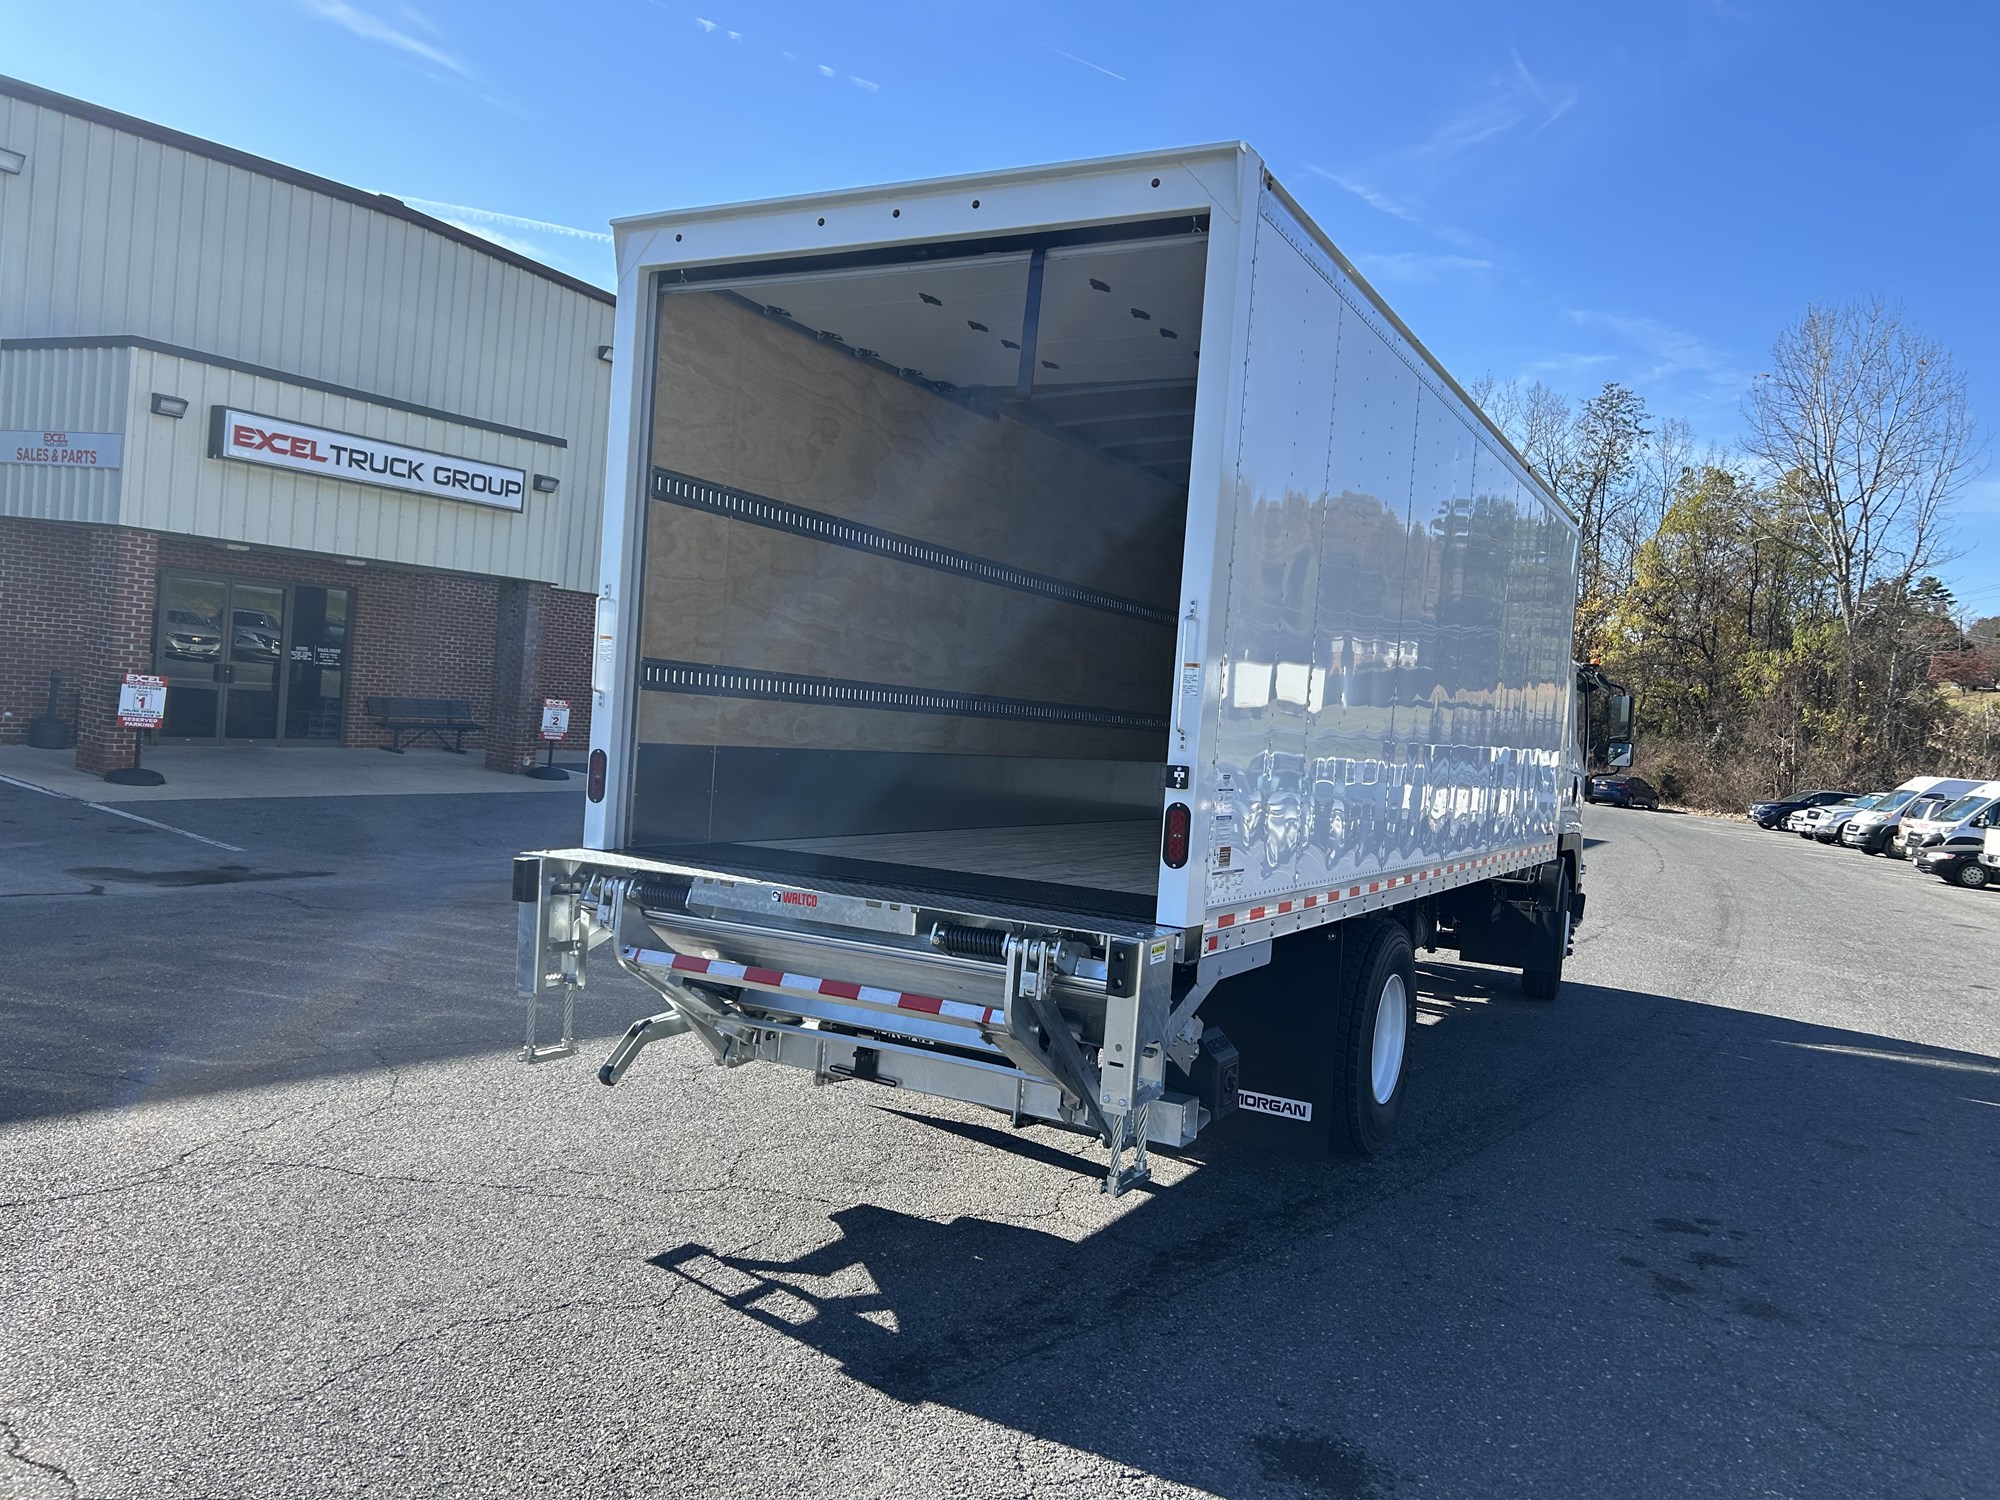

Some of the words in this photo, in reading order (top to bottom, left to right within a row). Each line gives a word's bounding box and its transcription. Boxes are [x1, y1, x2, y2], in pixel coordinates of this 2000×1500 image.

[44, 432, 68, 442] EXCEL
[16, 447, 49, 462] SALES
[51, 448, 59, 463] &
[61, 449, 97, 464] PARTS
[233, 424, 328, 463] EXCEL
[329, 444, 425, 482] TRUCK
[433, 465, 522, 498] GROUP
[126, 674, 164, 683] EXCEL
[783, 891, 817, 907] WALTCO
